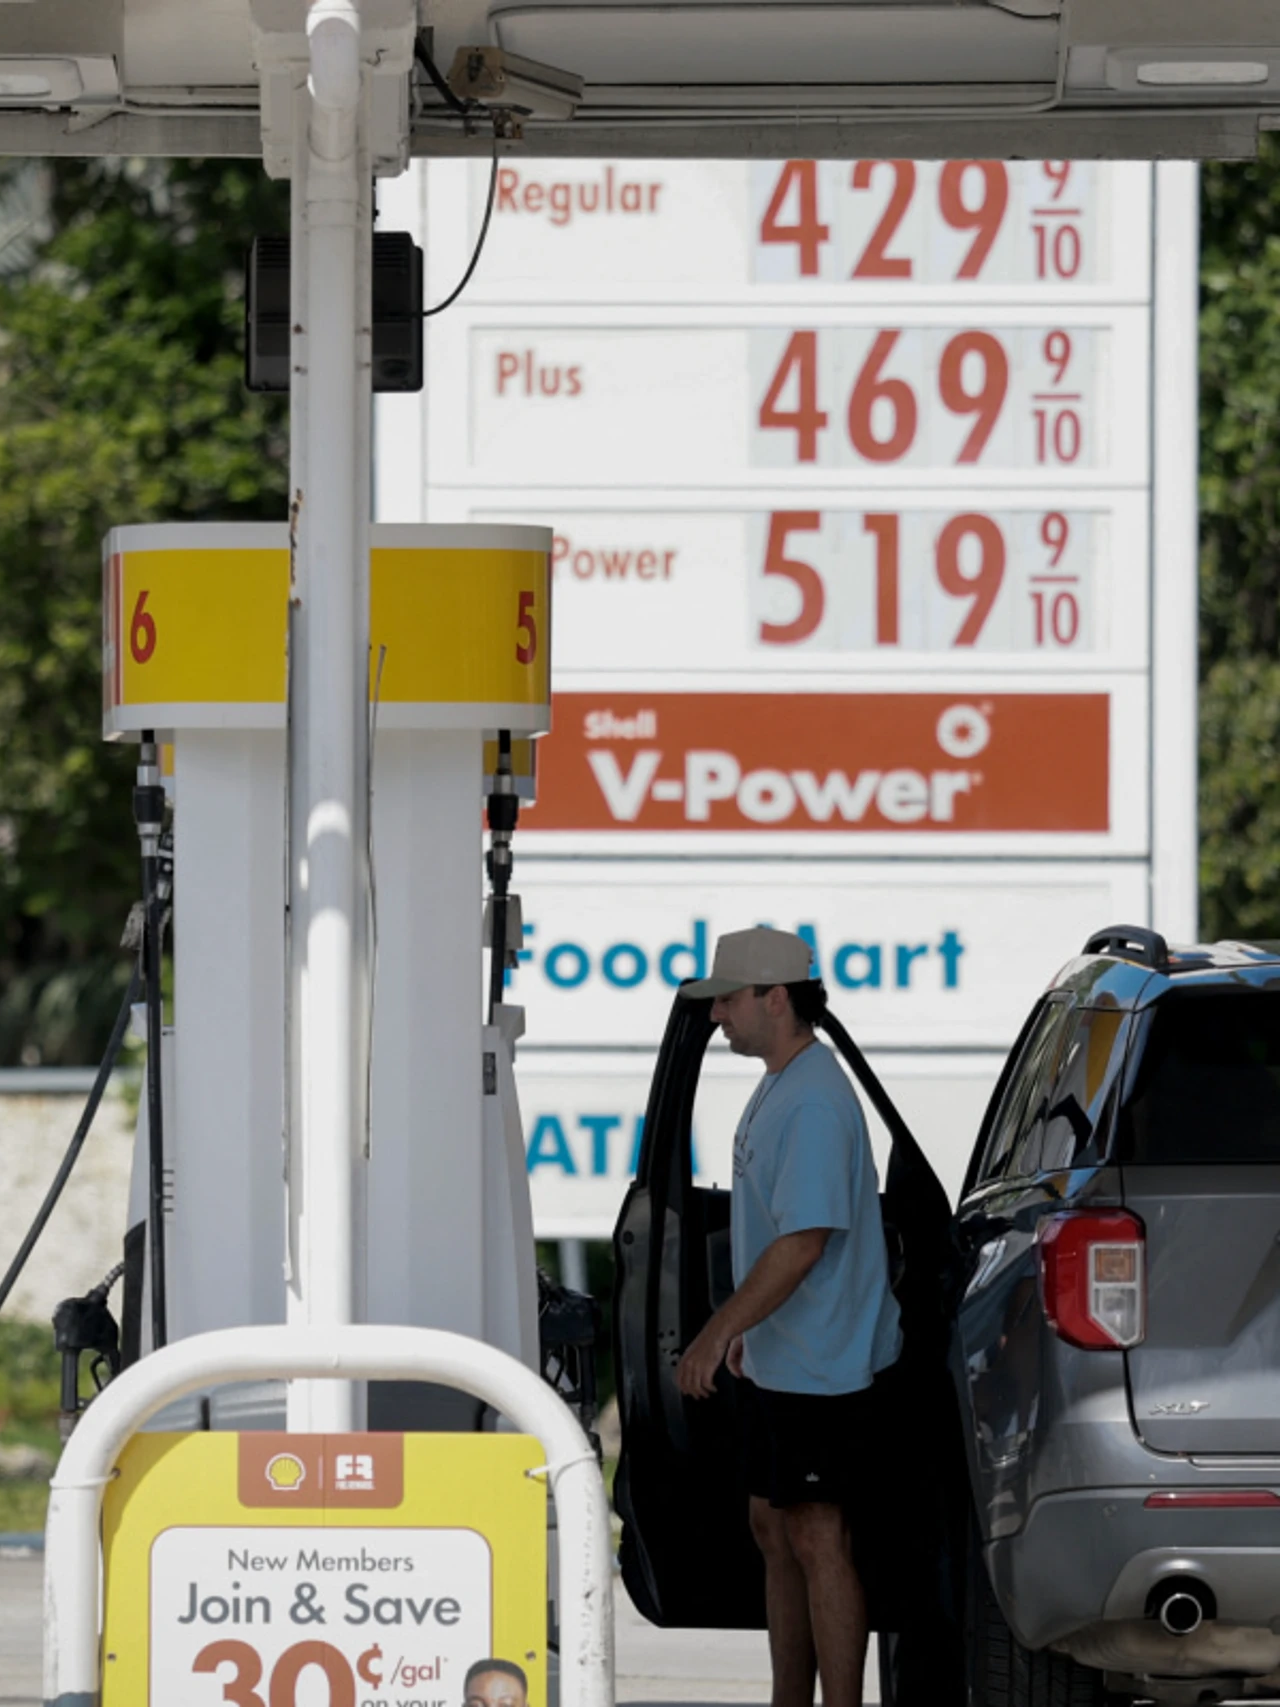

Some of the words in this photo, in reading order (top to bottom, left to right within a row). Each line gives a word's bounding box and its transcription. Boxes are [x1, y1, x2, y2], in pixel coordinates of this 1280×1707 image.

[1043, 159, 1073, 200] 9
[497, 167, 663, 227] Regular
[760, 159, 1011, 281] 429
[1034, 225, 1083, 281] 10
[1043, 330, 1074, 385] 9
[497, 351, 584, 398] Plus
[759, 329, 1011, 464] 469
[1034, 409, 1083, 465] 10
[1040, 512, 1071, 567] 9
[552, 534, 677, 581] Power
[759, 510, 1008, 648] 519
[130, 590, 157, 664] 6
[515, 590, 538, 665] 5
[1032, 592, 1081, 648] 10
[584, 710, 658, 741] Shell
[586, 749, 970, 823] V-Power
[755, 922, 966, 991] art
[228, 1550, 288, 1573] New
[297, 1548, 415, 1573] Members
[178, 1582, 272, 1626] Join
[288, 1583, 328, 1627] &
[343, 1583, 463, 1628] Save
